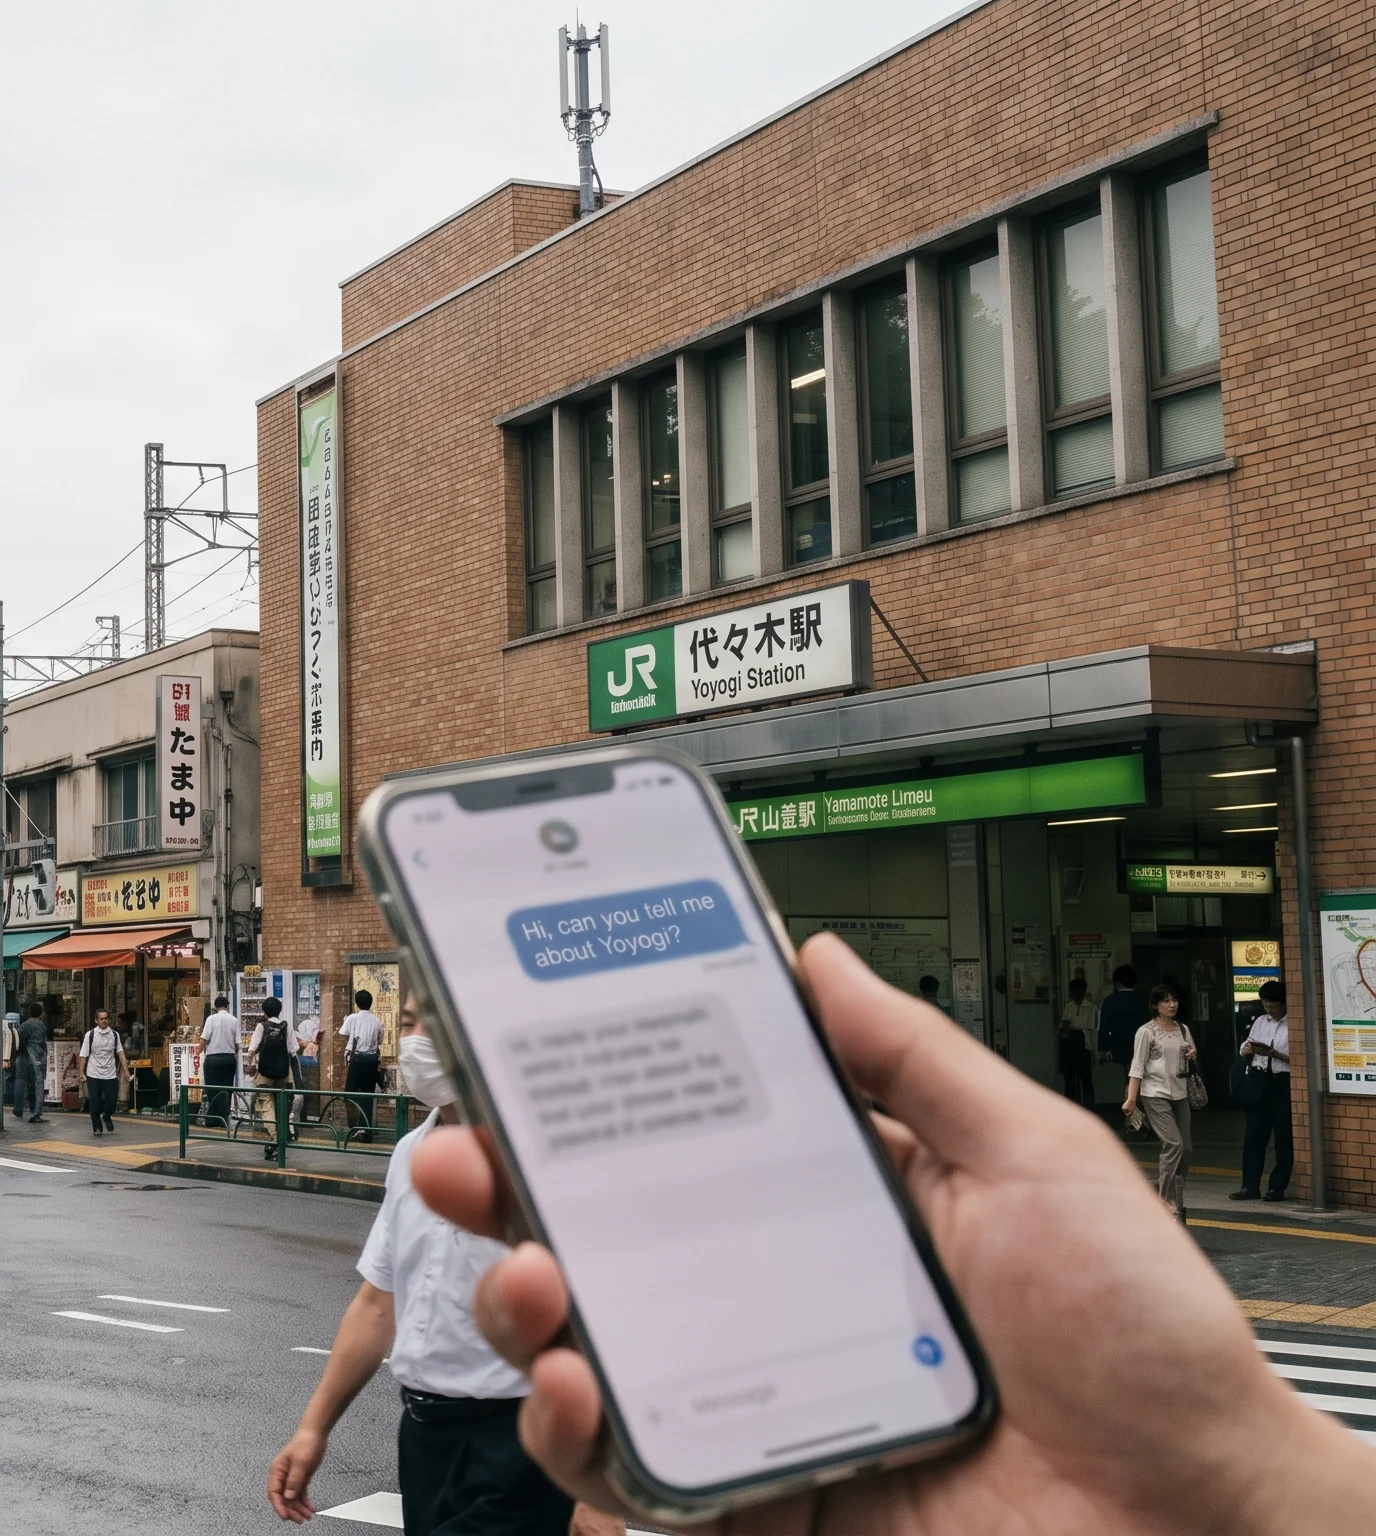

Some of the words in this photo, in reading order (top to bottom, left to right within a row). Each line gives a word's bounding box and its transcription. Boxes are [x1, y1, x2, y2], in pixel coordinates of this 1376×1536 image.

[690, 602, 823, 673] 代々木駅
[607, 644, 658, 697] JR
[691, 671, 742, 702] Yoyogi
[747, 663, 805, 689] Station
[824, 793, 888, 814] Yamamote
[521, 920, 553, 942] Hi,
[558, 915, 597, 935] can
[600, 907, 641, 932] you
[643, 897, 678, 920] tell
[681, 894, 716, 914] me
[534, 940, 597, 968] about
[597, 924, 681, 956] Yoyogi?
